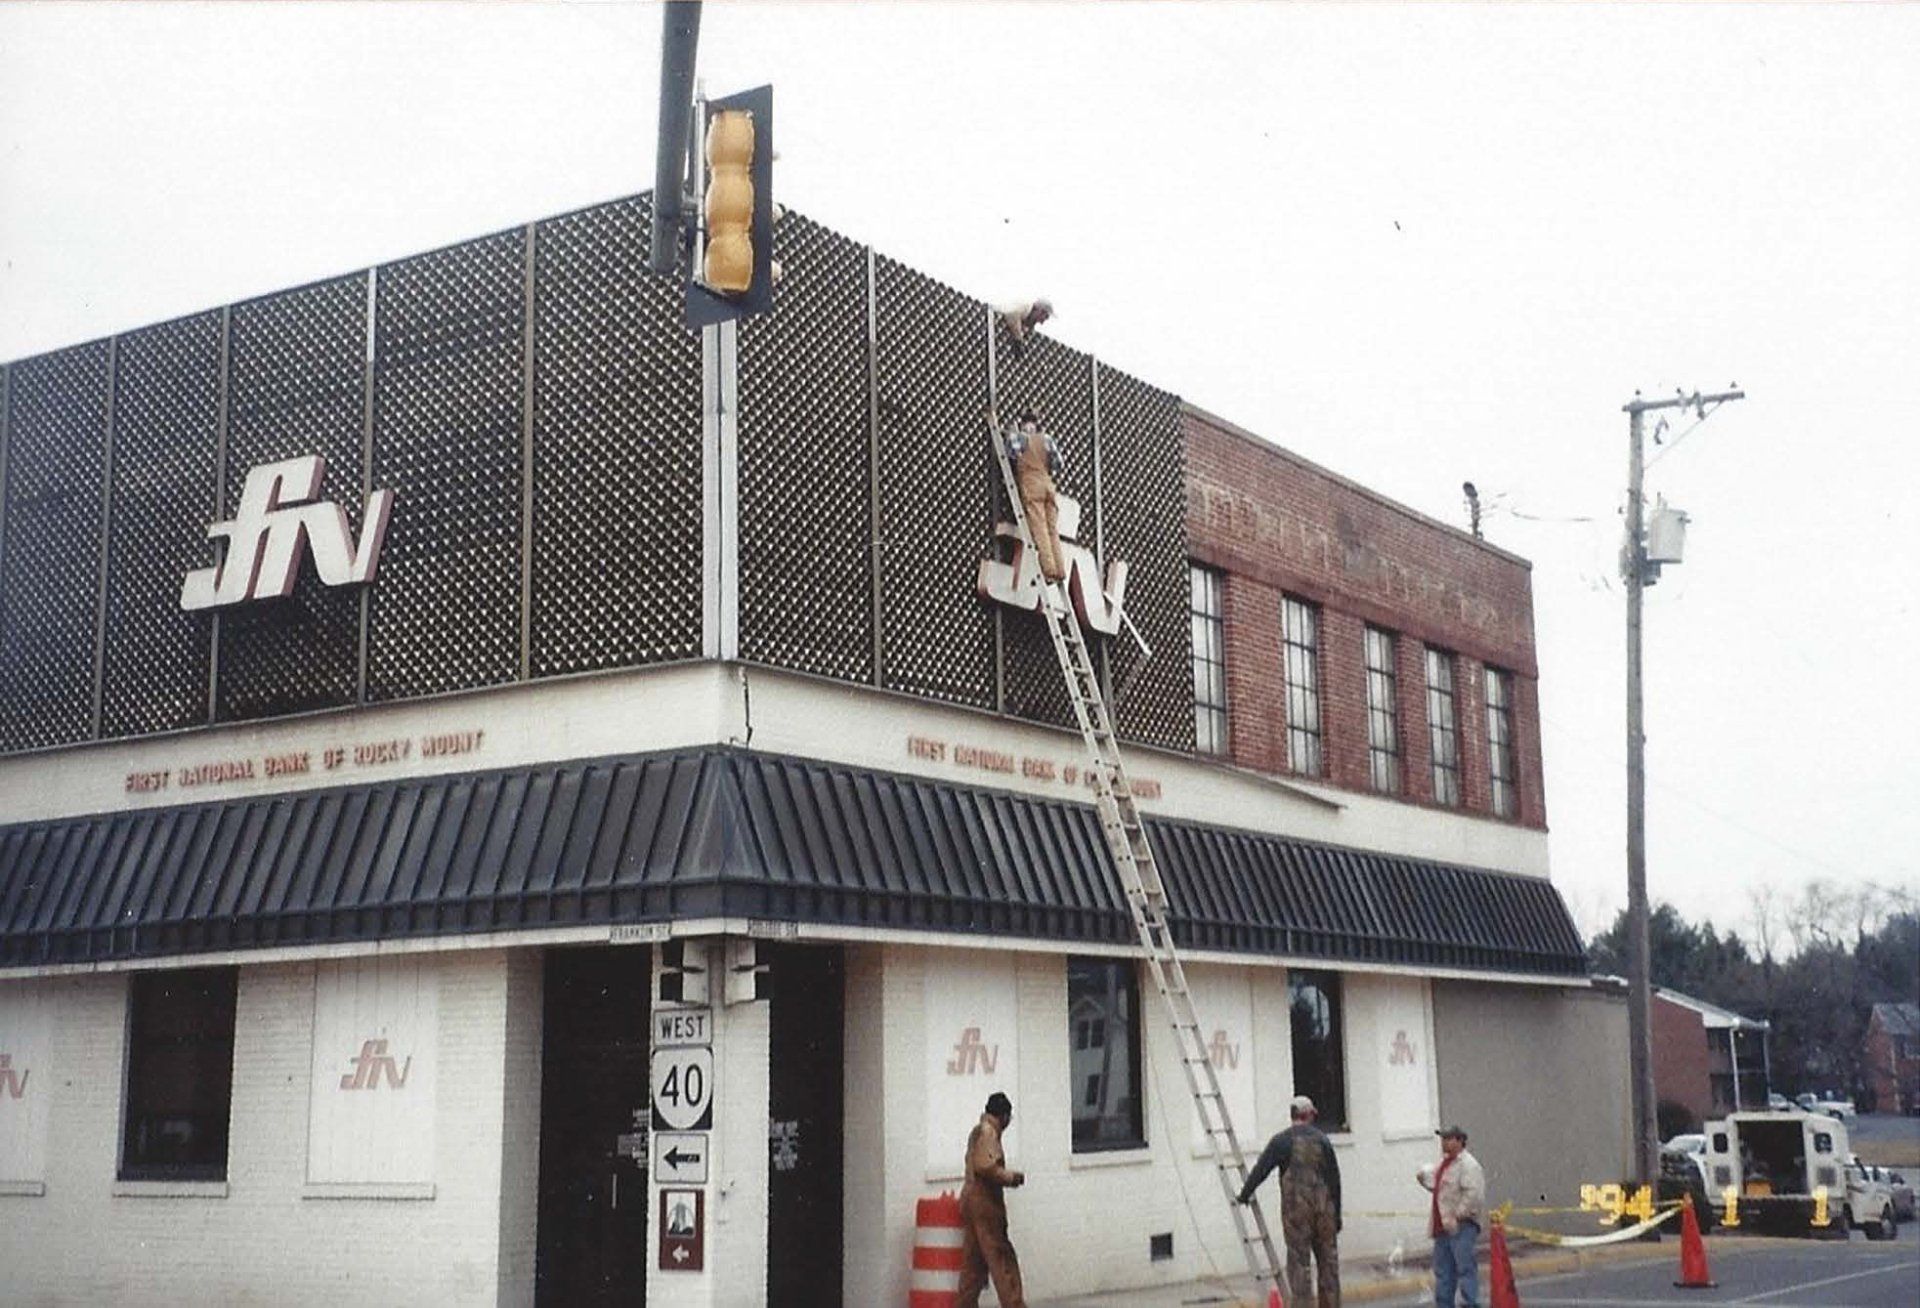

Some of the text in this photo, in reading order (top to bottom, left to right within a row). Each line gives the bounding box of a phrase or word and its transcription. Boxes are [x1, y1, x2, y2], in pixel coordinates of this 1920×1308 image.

[125, 729, 484, 792] FIRST NATIONAL BANK OF ROCKY MOUNT
[661, 1015, 705, 1038] WEST
[660, 1064, 703, 1107] 40
